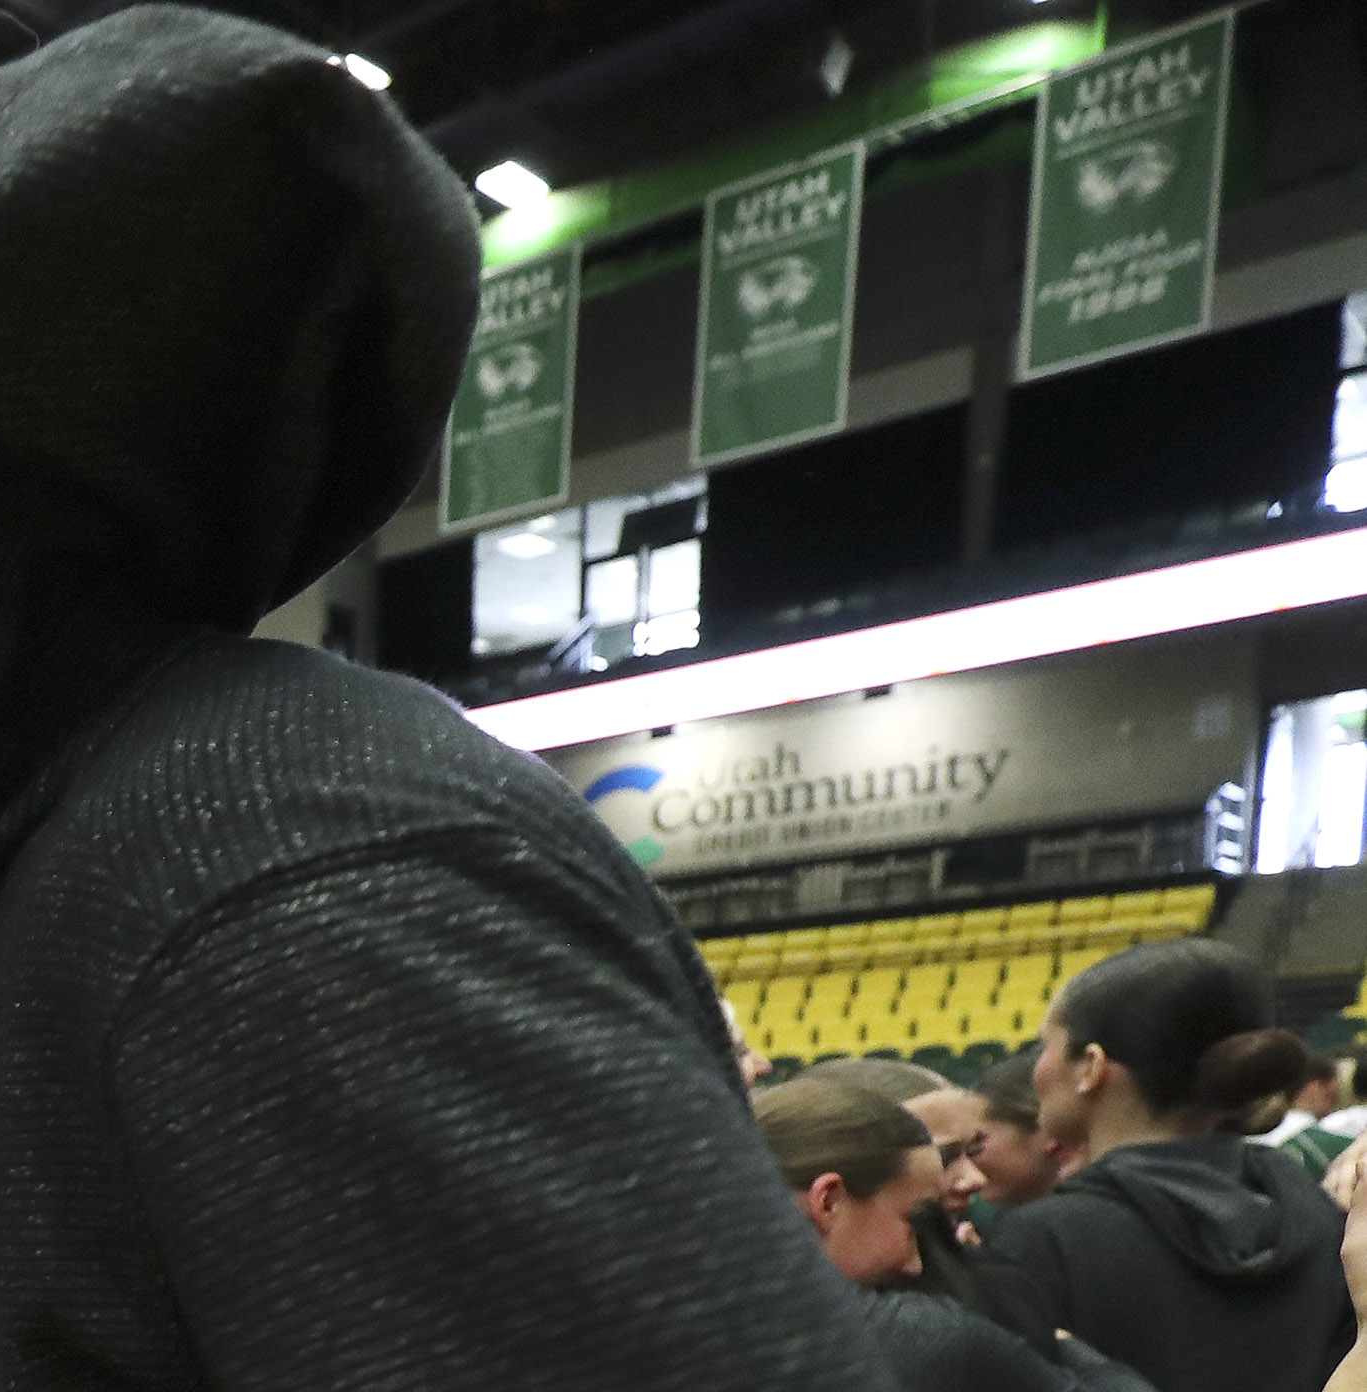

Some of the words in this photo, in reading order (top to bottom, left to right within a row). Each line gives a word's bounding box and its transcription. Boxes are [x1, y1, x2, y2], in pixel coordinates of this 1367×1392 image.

[1076, 46, 1189, 102] UTAH
[1054, 68, 1212, 142] VALLEY
[720, 191, 845, 252] VALLEY
[736, 171, 829, 221] UTAH
[650, 747, 1010, 835] Community
